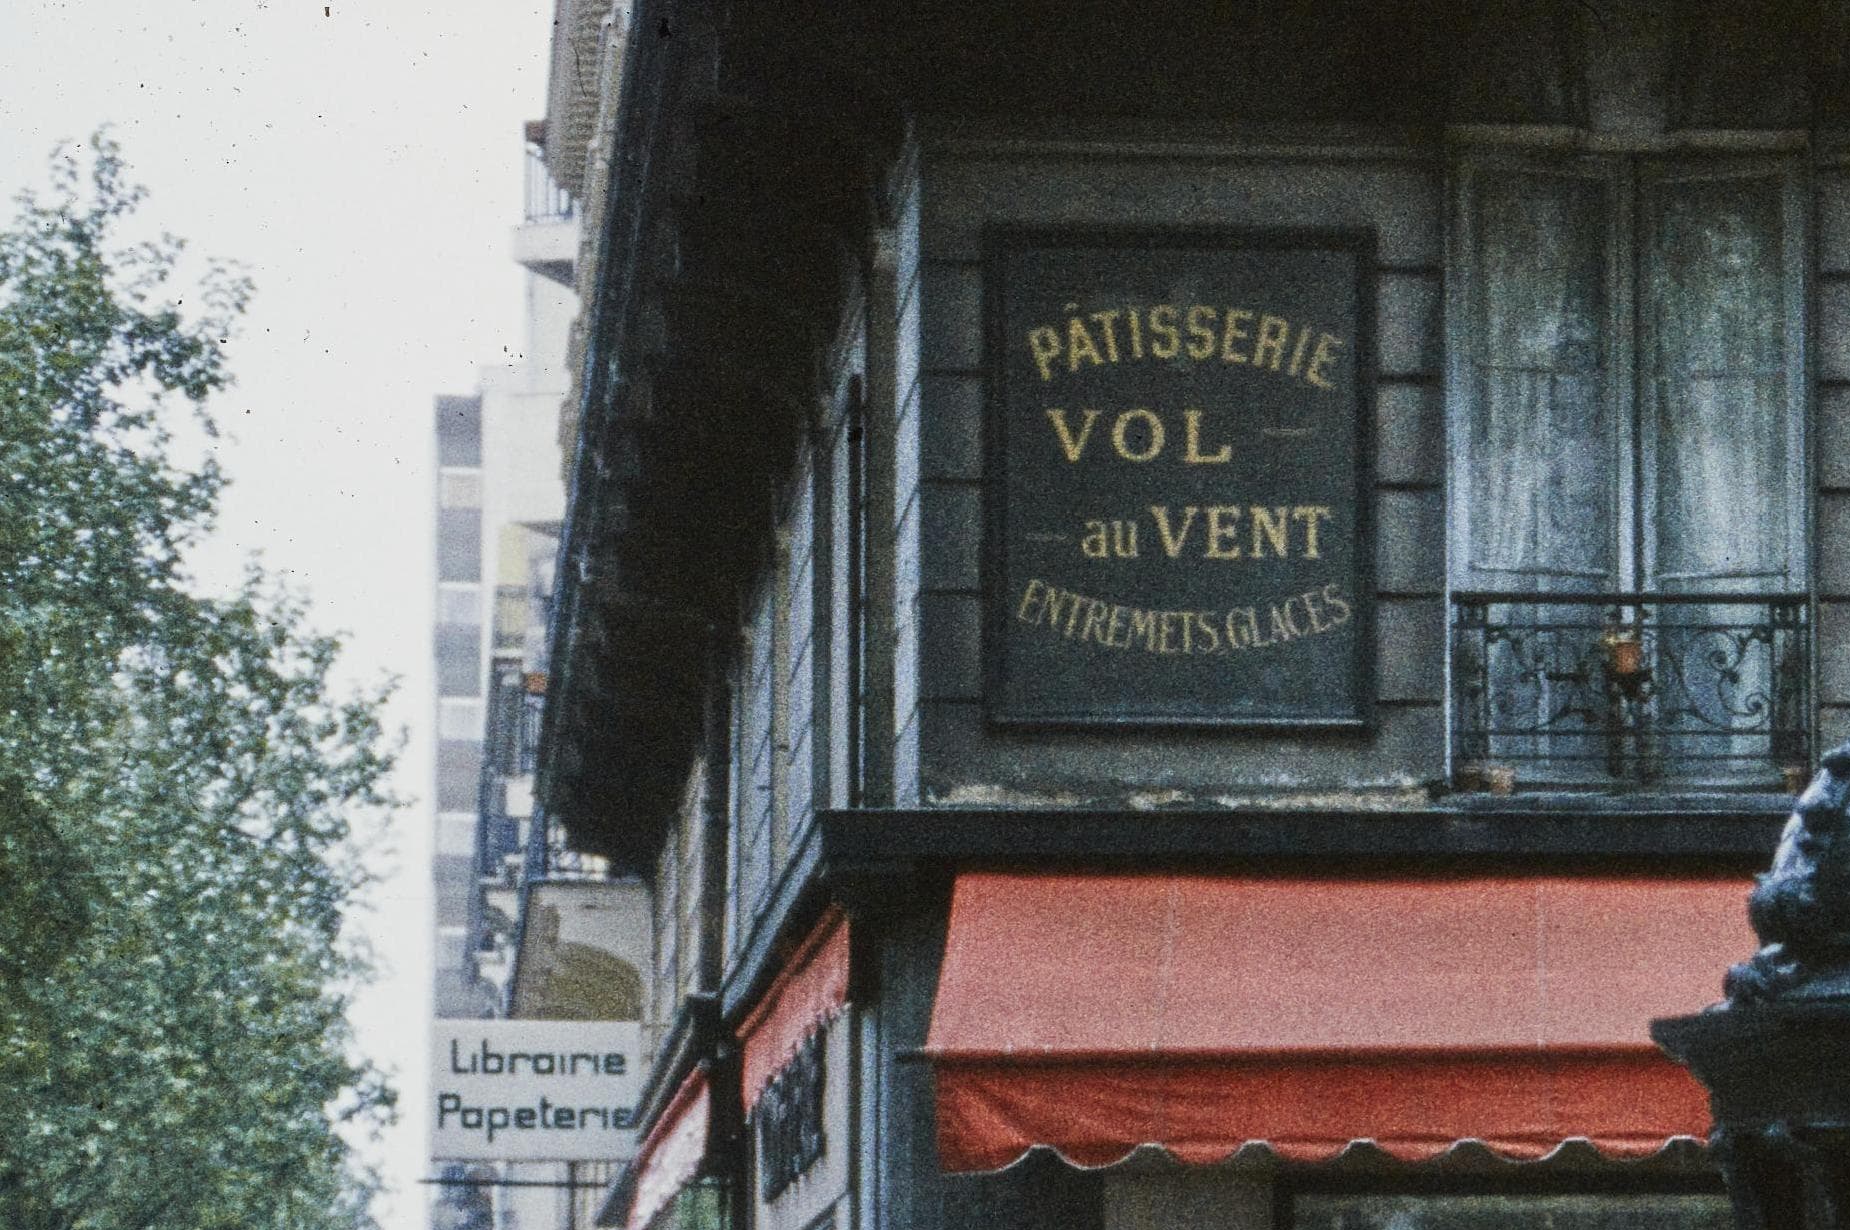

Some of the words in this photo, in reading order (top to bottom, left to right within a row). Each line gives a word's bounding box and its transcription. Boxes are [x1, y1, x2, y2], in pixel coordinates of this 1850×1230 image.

[1027, 302, 1345, 390] PÂTISSERIE
[1046, 408, 1232, 463] VOL
[1081, 518, 1138, 559] au
[1151, 504, 1332, 560] VENT
[1016, 578, 1219, 656] ENTREMETS
[1223, 583, 1352, 650] GLACES
